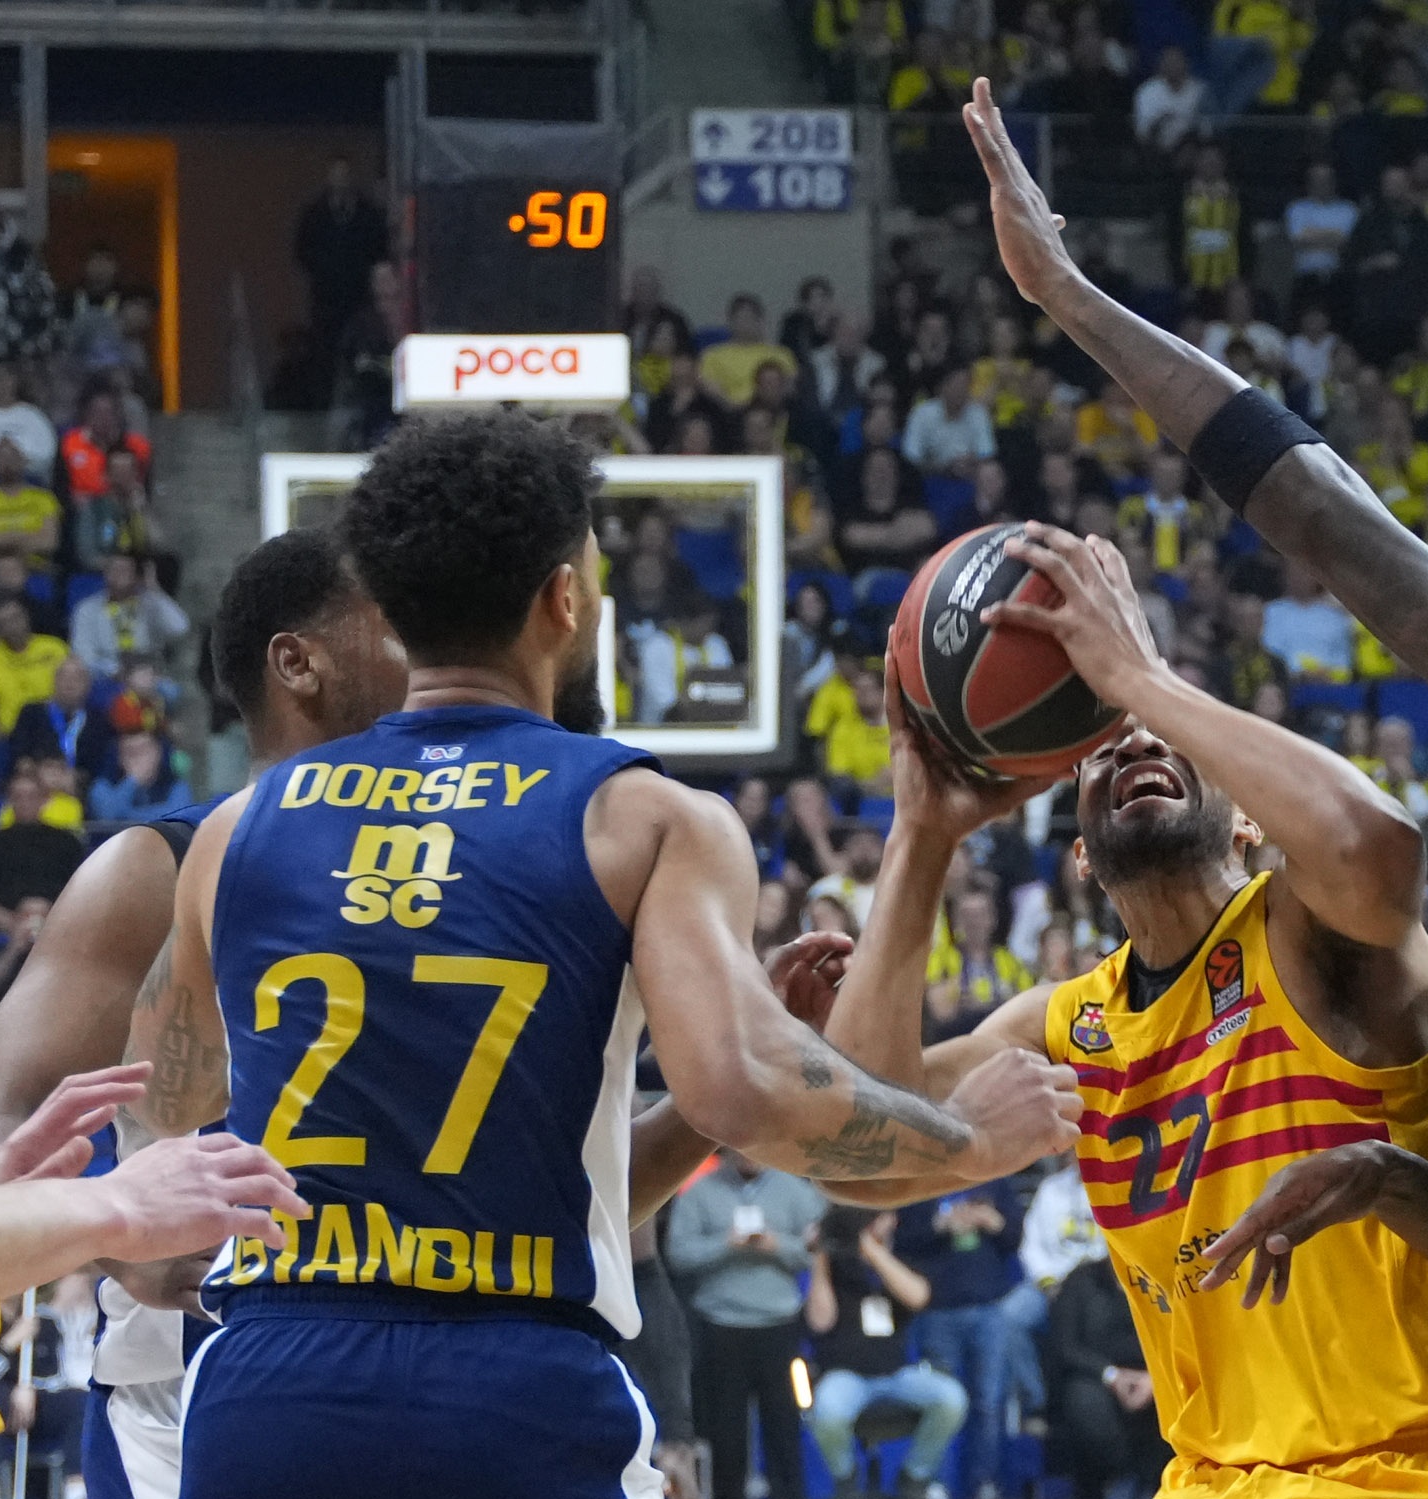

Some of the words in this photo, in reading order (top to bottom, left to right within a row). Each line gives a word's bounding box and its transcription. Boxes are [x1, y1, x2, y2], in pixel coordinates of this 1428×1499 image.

[749, 116, 843, 154] 208
[749, 169, 846, 209] 108
[454, 346, 579, 390] poca
[279, 760, 550, 814] DORSEY
[254, 952, 549, 1176] 27
